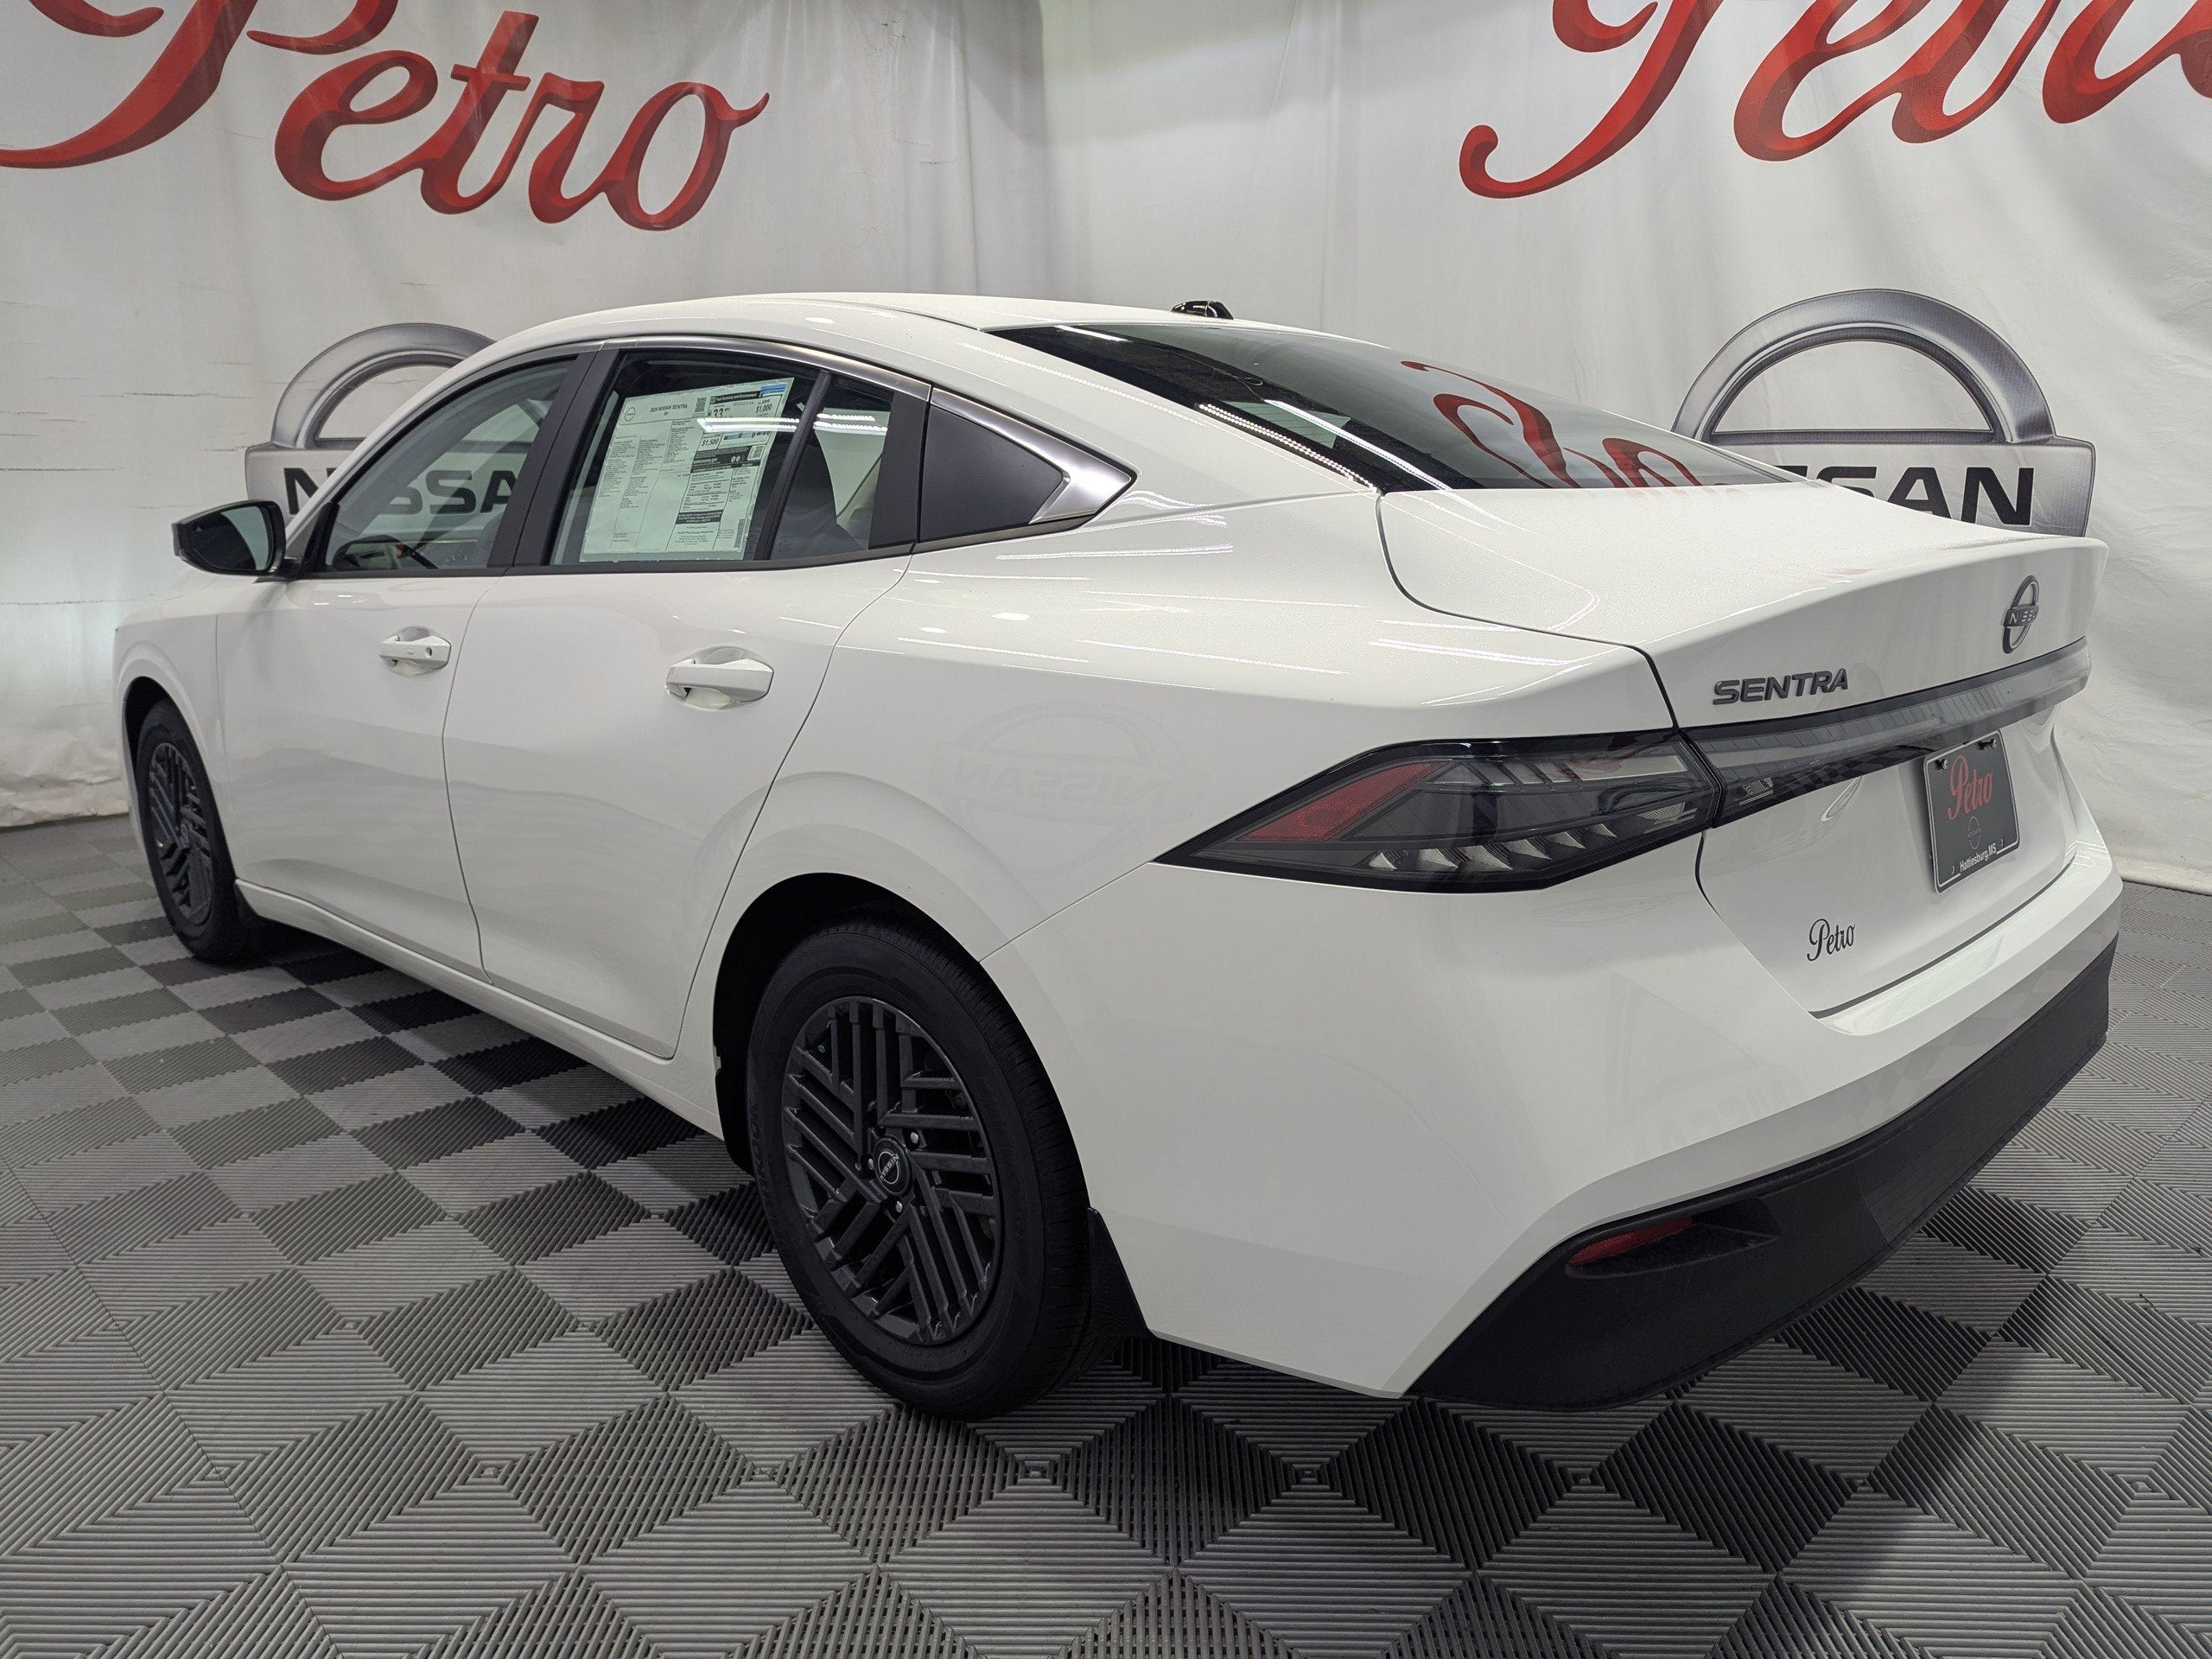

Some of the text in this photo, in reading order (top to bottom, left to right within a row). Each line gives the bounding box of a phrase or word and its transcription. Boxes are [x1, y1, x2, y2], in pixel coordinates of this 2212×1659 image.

[1459, 0, 2212, 199] etr
[1712, 668, 1849, 705] SENTRA
[1947, 753, 1994, 821] Petro
[1806, 918, 1856, 962] Petro
